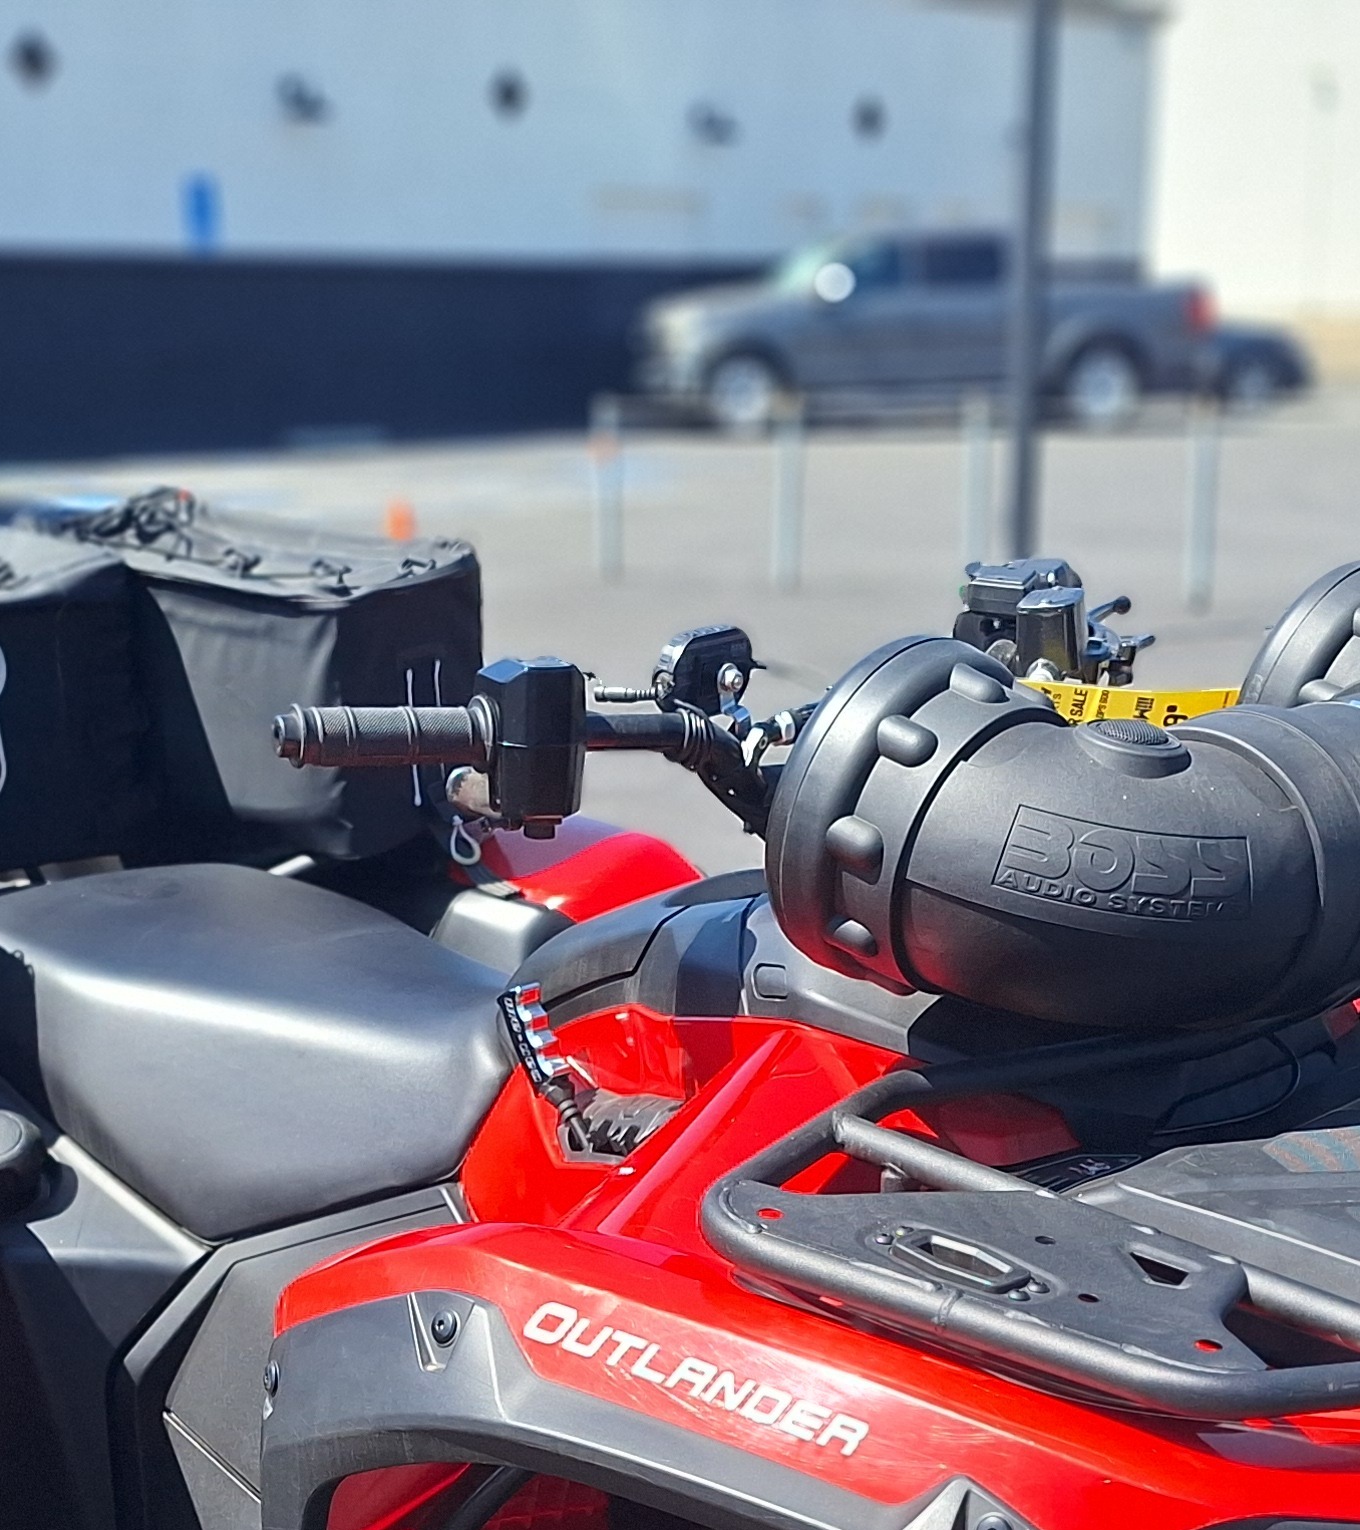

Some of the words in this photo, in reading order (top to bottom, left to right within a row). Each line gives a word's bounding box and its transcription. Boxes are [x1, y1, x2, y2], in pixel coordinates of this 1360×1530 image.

[1069, 688, 1088, 717] SALE
[1004, 814, 1247, 898] BOSS
[997, 869, 1097, 908] AUDIO
[521, 1301, 871, 1457] OUTLANDER
